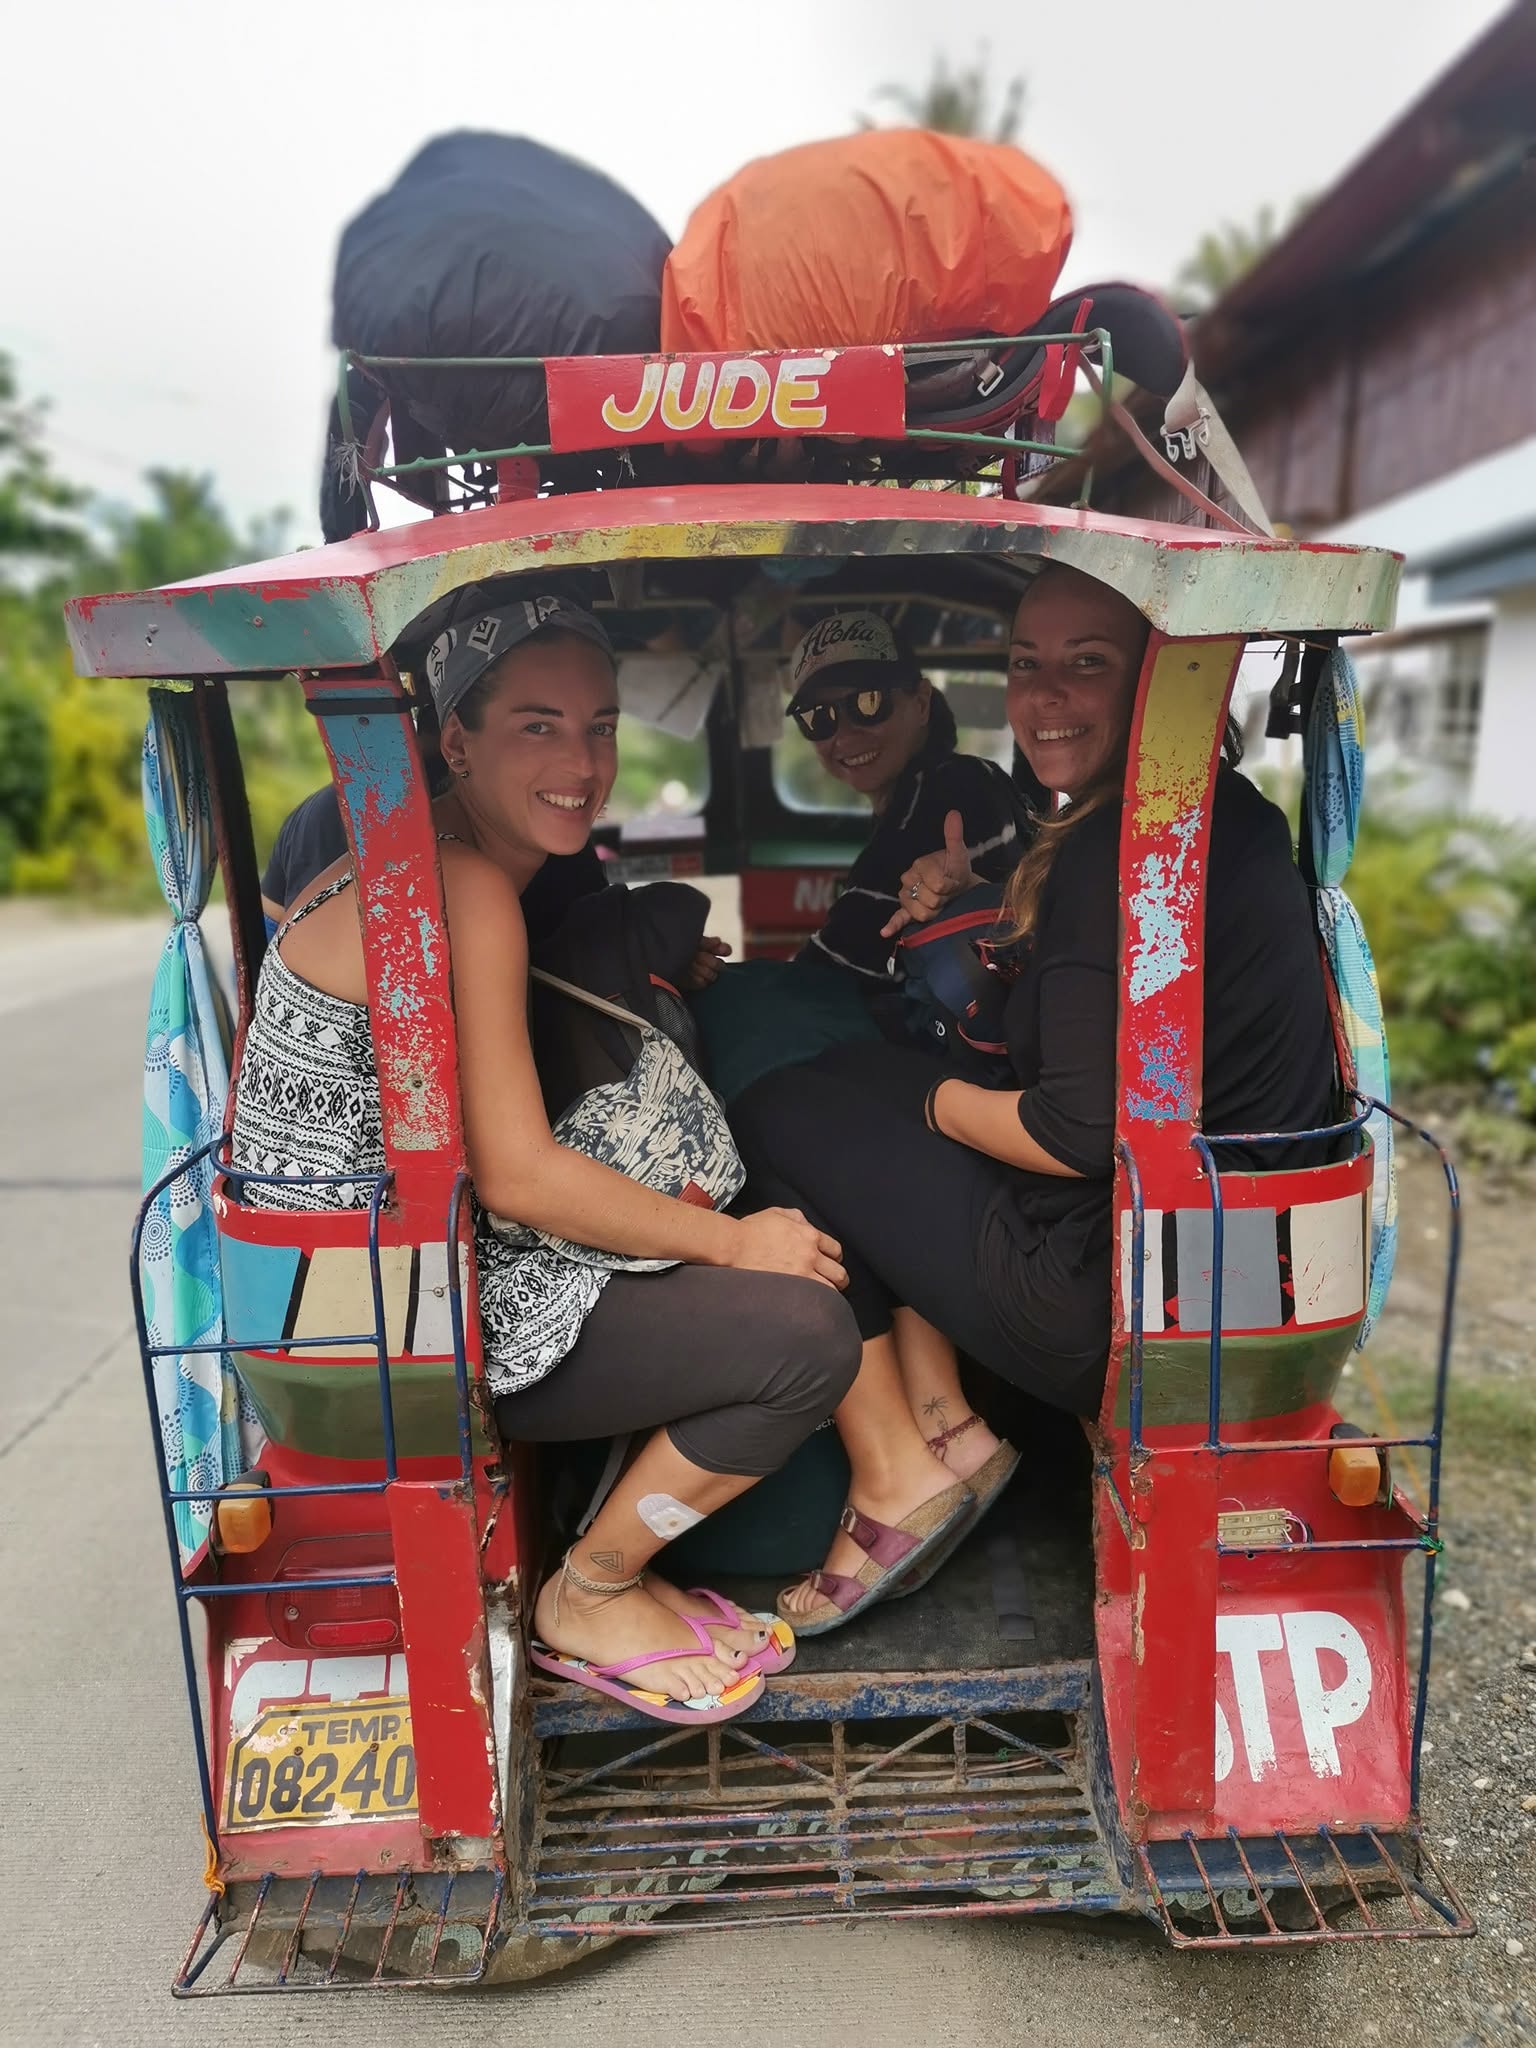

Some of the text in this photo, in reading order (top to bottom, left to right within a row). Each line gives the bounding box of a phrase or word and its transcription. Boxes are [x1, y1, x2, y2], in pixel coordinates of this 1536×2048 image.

[602, 358, 831, 432] JUDE
[795, 620, 875, 680] Aloha
[1215, 1611, 1372, 1783] TP
[238, 1744, 416, 1818] 08240
